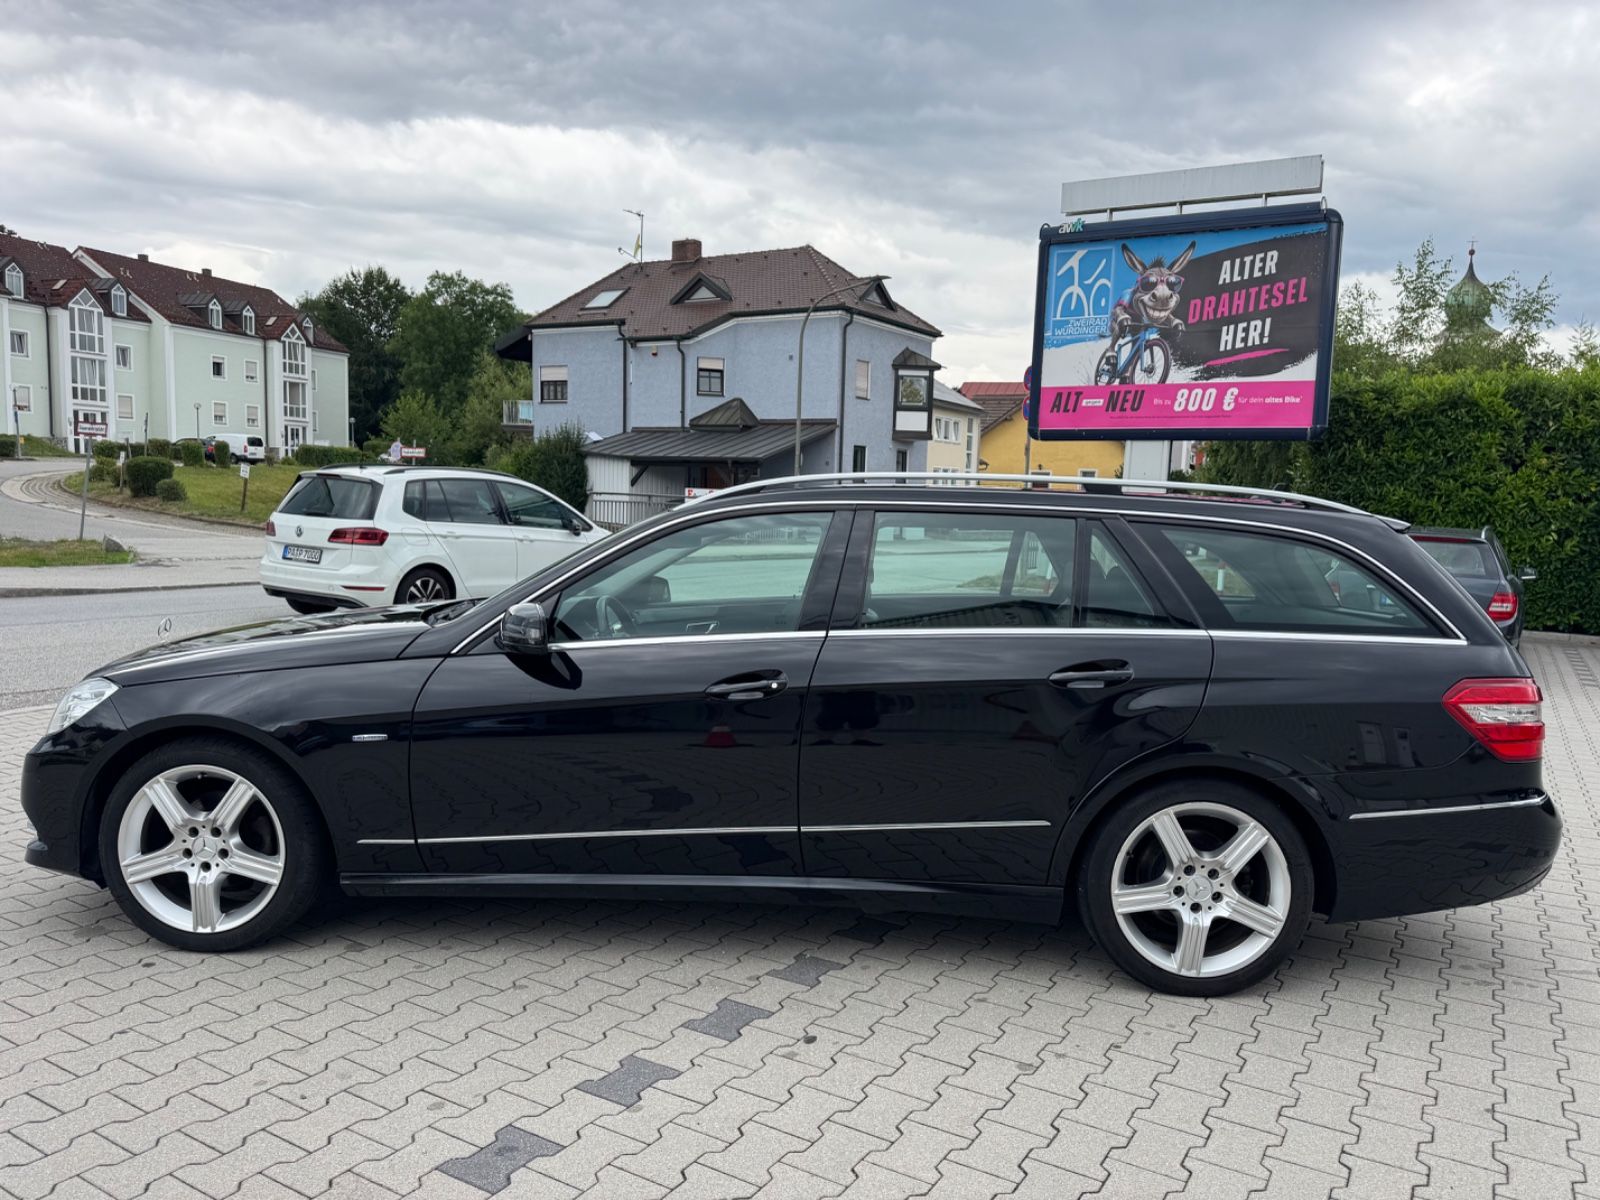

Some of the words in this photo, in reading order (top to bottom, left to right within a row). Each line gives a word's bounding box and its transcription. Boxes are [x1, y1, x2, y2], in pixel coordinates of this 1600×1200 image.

[1218, 250, 1279, 285] ALTER
[1188, 277, 1308, 325] DRAHTESEL
[1068, 317, 1108, 327] ZWEIRAD
[1219, 317, 1272, 352] HER!
[1049, 391, 1083, 413] ALT
[1105, 390, 1145, 412] NEU
[1173, 388, 1217, 412] 800
[1222, 387, 1239, 411] €
